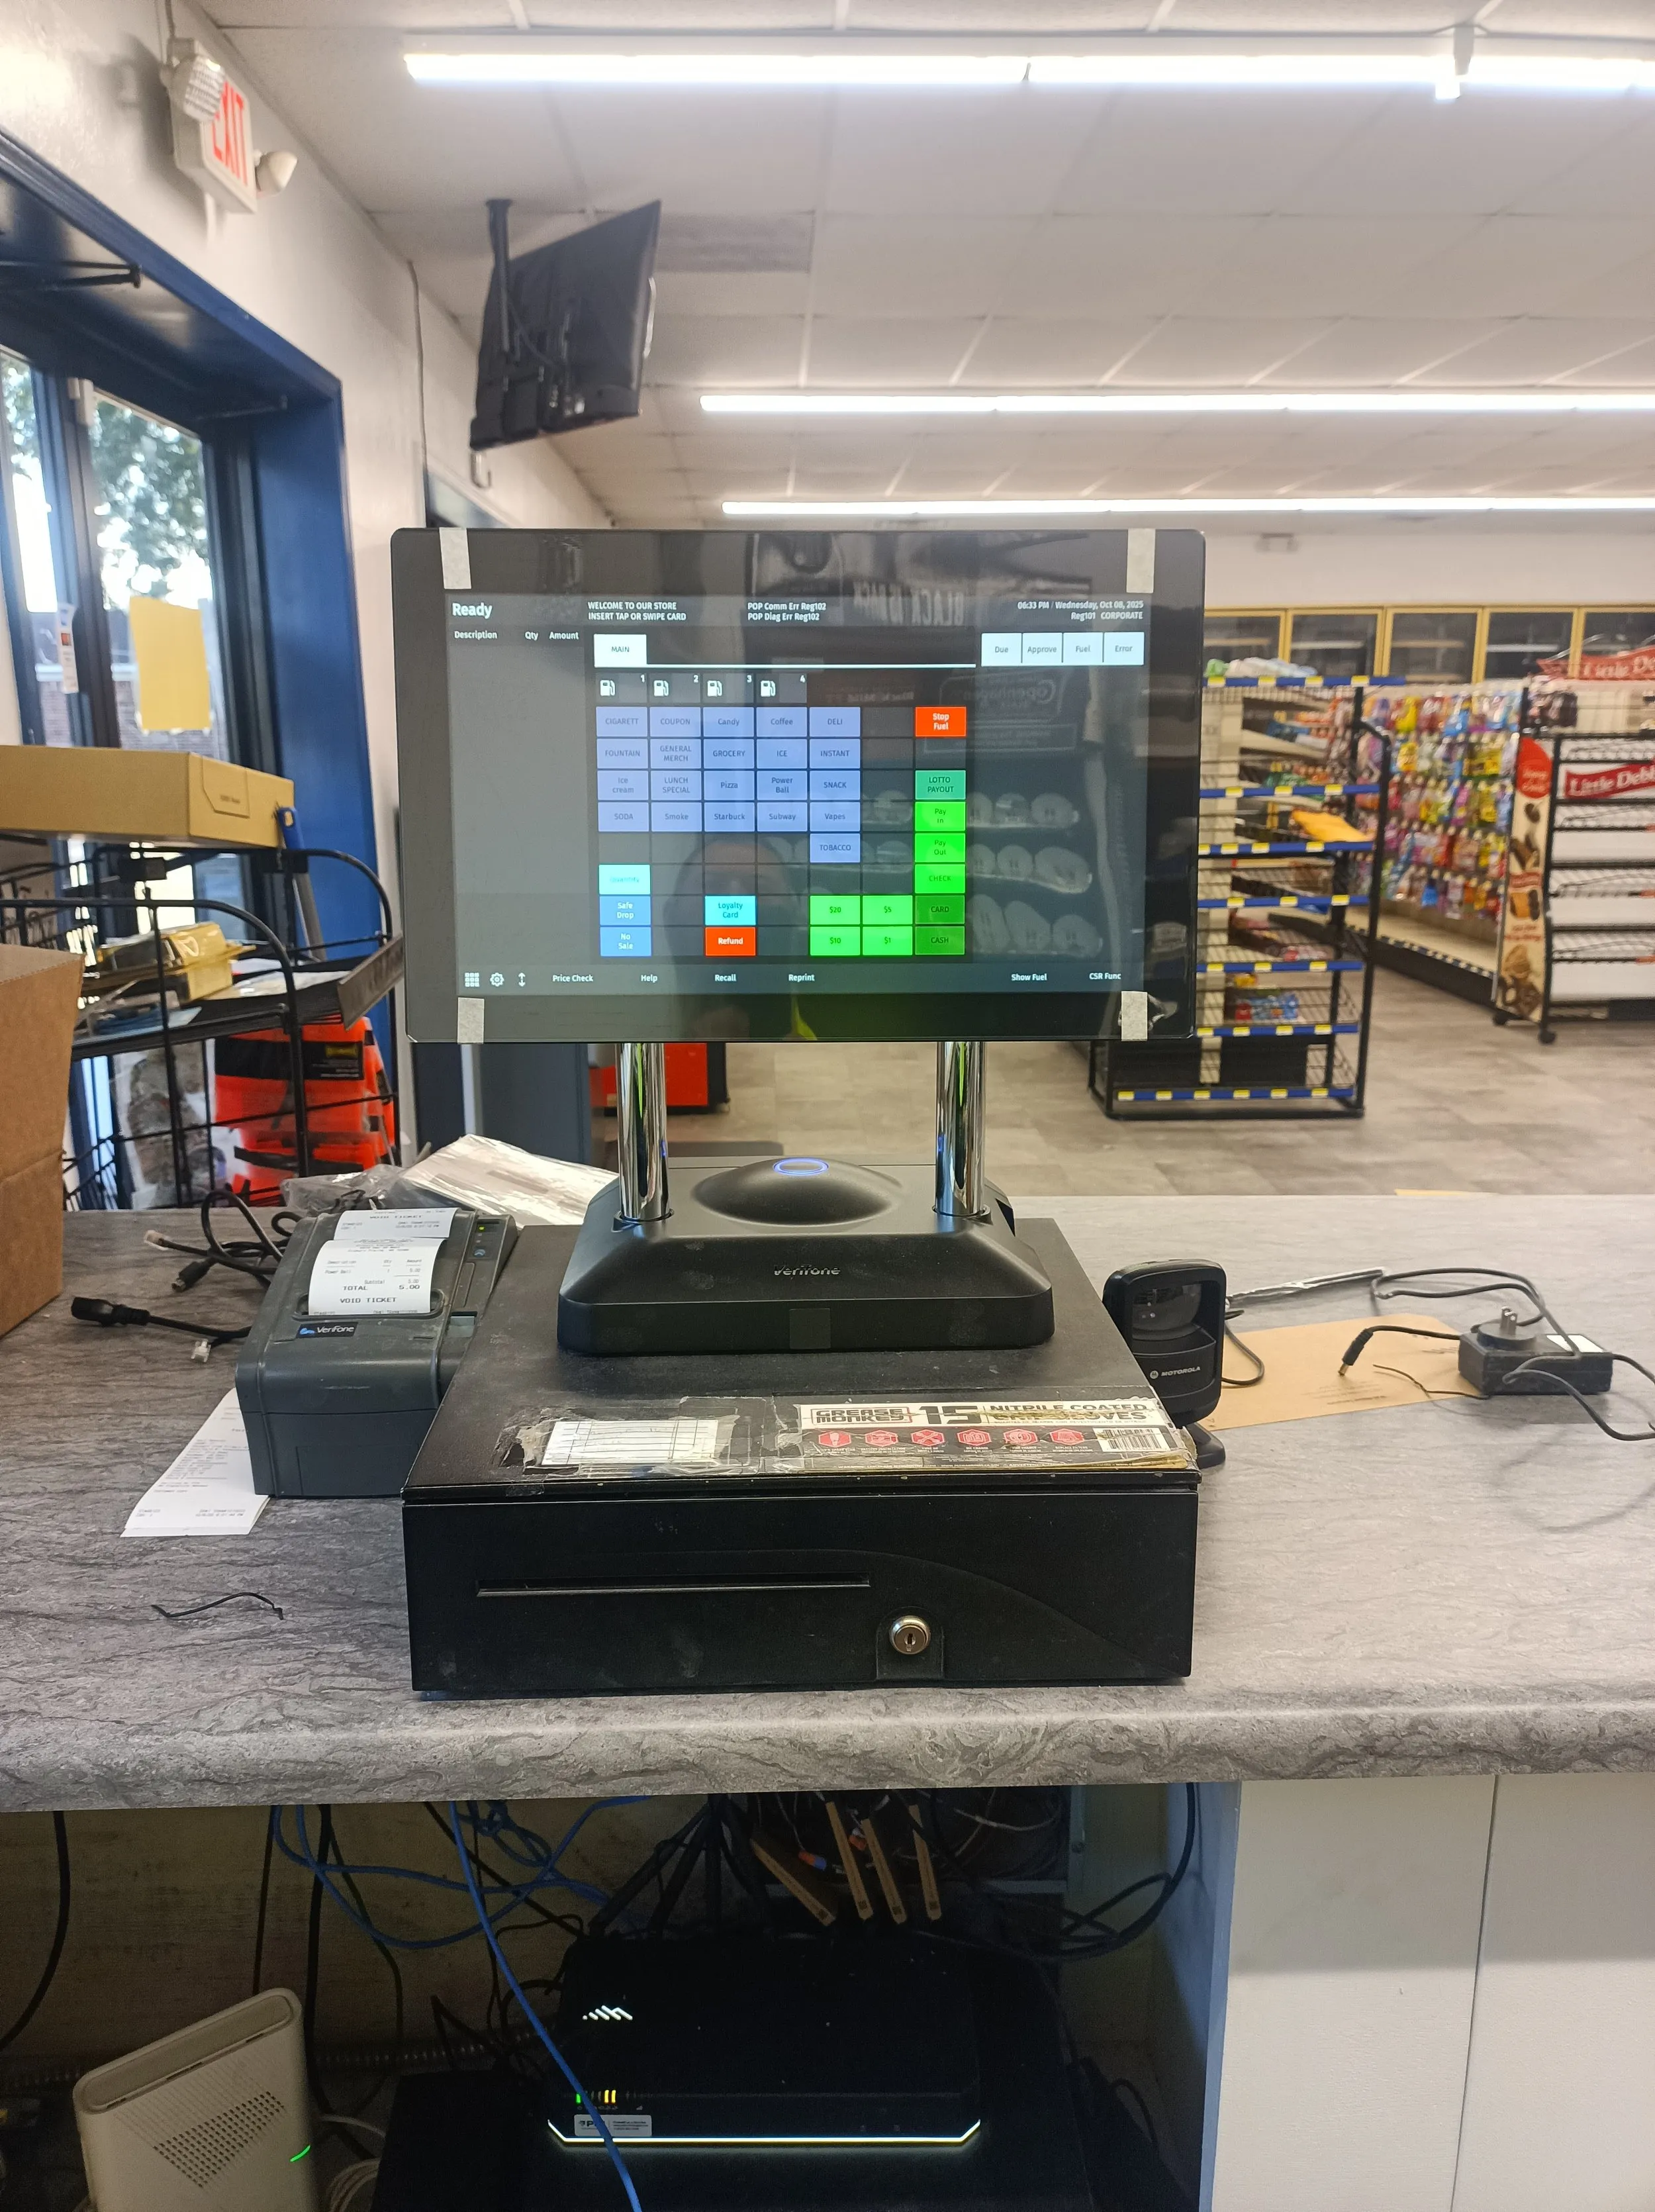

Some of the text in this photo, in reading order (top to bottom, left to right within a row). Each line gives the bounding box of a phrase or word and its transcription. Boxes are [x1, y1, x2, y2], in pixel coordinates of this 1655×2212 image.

[802, 602, 826, 612] Reg102
[1055, 601, 1098, 610] Wednesday,
[1113, 601, 1125, 610] 08,
[452, 603, 493, 618] Ready
[643, 612, 663, 621] SWIPE
[665, 612, 686, 621] CARD
[764, 612, 780, 622] Diag
[794, 612, 820, 622] Reg102
[1070, 612, 1096, 621] Reg101
[454, 630, 498, 640] Description
[525, 632, 539, 642] Qty
[1027, 646, 1057, 655] Approve
[933, 712, 949, 722] Stop
[718, 718, 740, 727] Candy
[933, 722, 949, 730] Fuel
[769, 812, 796, 822] Subway
[934, 808, 947, 817] Pay
[824, 813, 845, 822] Vapes
[934, 840, 947, 849] Pay
[718, 902, 743, 911] Loyalty
[829, 905, 841, 914] $20
[884, 905, 892, 914] $5
[616, 911, 634, 920] Drop
[829, 936, 841, 945] $10
[884, 936, 892, 945] $1
[641, 974, 658, 983] Help
[788, 973, 815, 983] Reprint
[317, 1325, 355, 1334] VeriFone
[1161, 1366, 1200, 1376] MOTOROLA
[920, 1405, 981, 1424] 15
